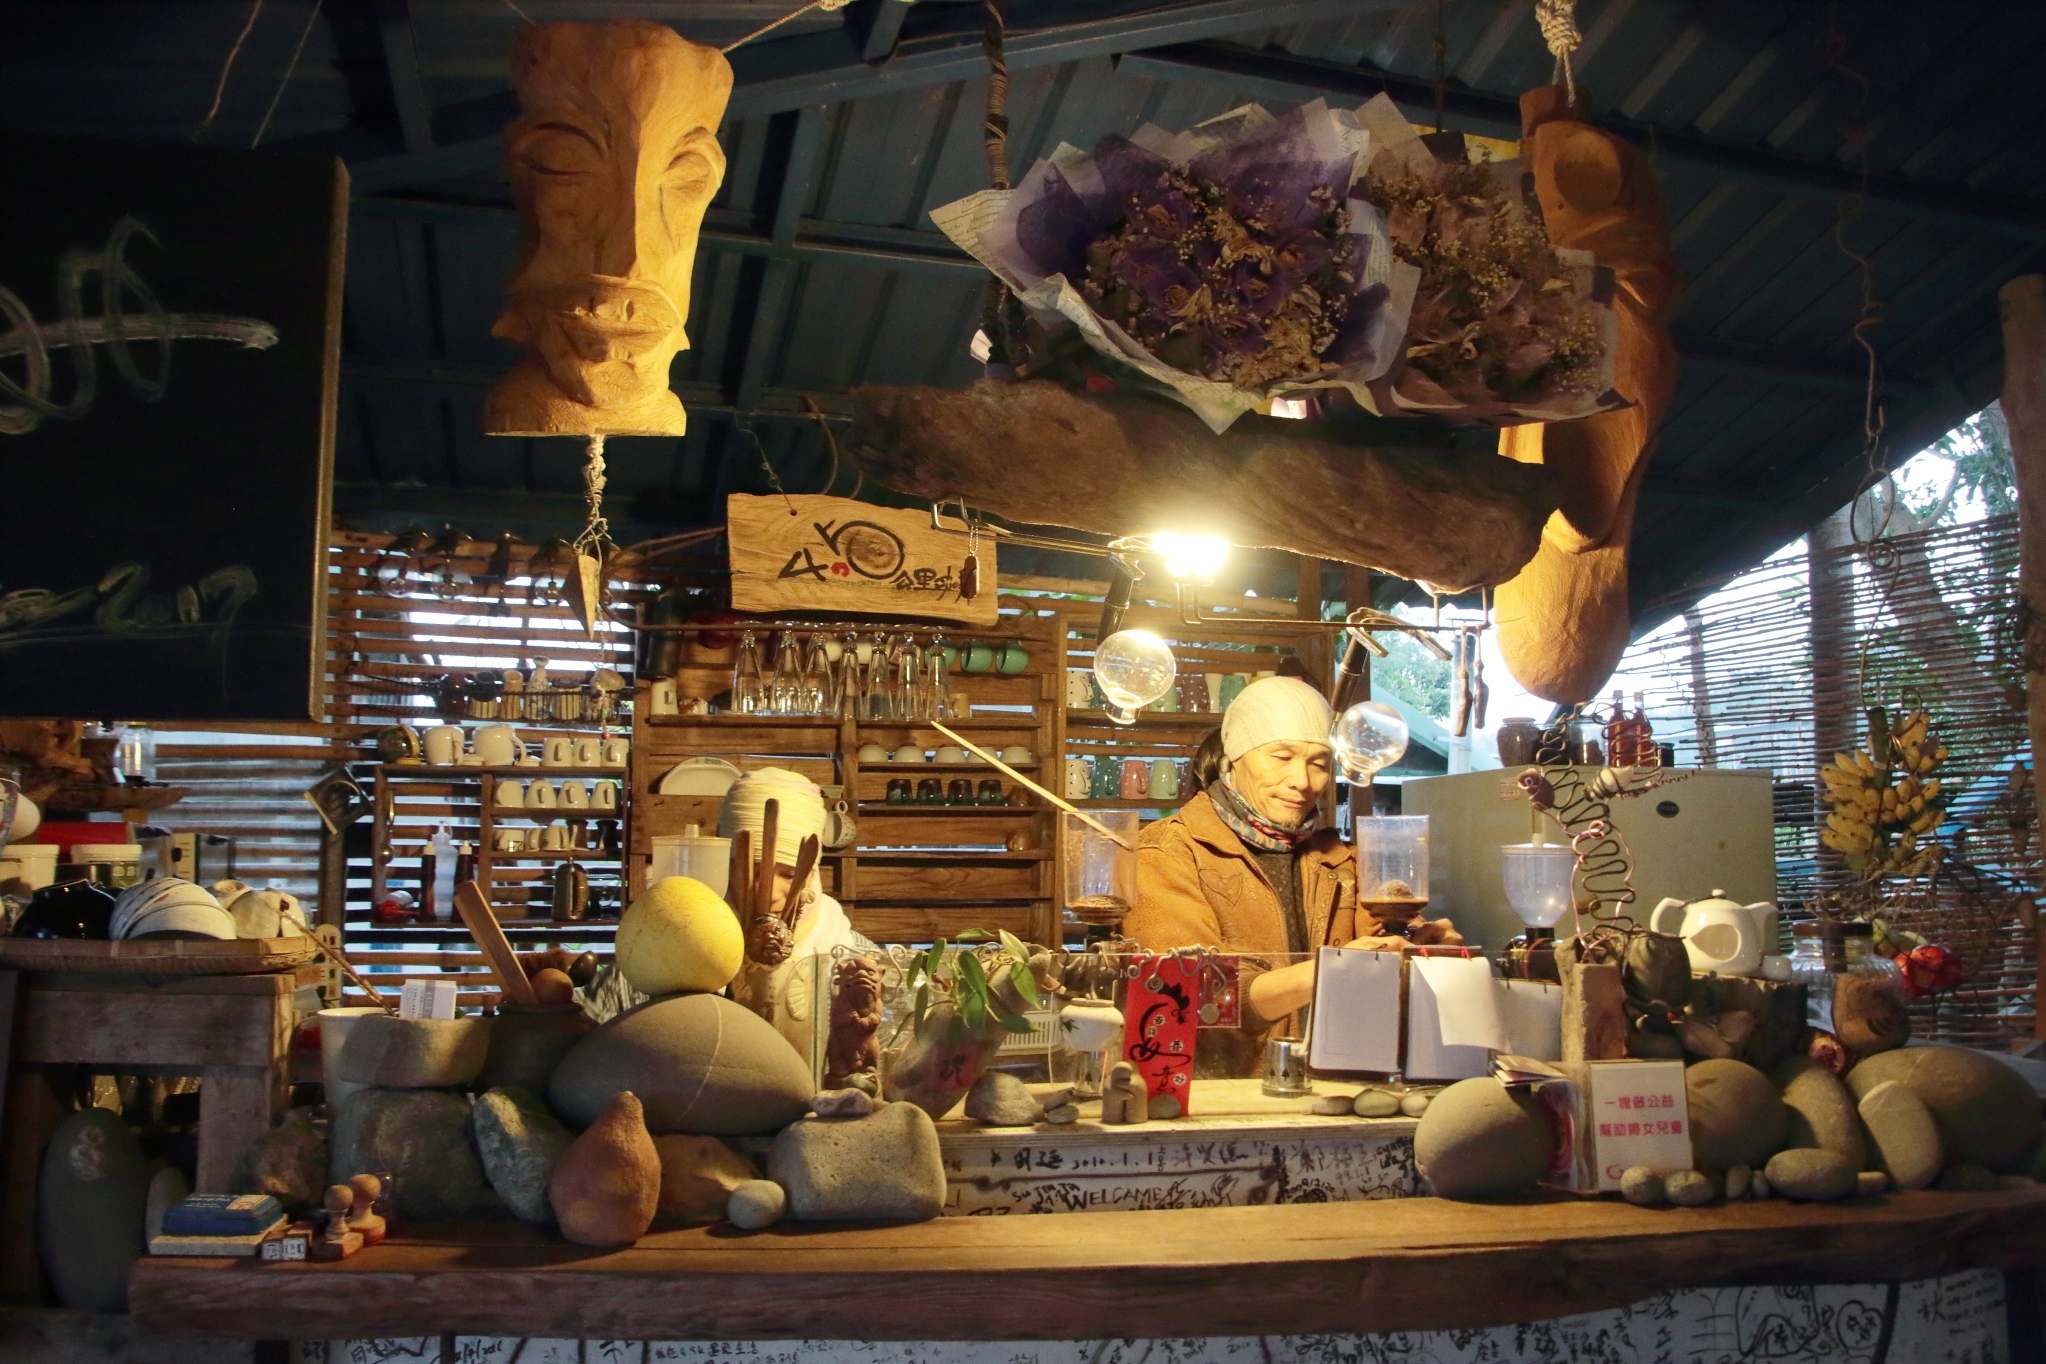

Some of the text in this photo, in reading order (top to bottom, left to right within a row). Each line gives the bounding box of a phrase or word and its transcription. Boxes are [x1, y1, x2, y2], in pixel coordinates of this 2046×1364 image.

[1599, 1120, 1682, 1137] 幫助婦女兒童
